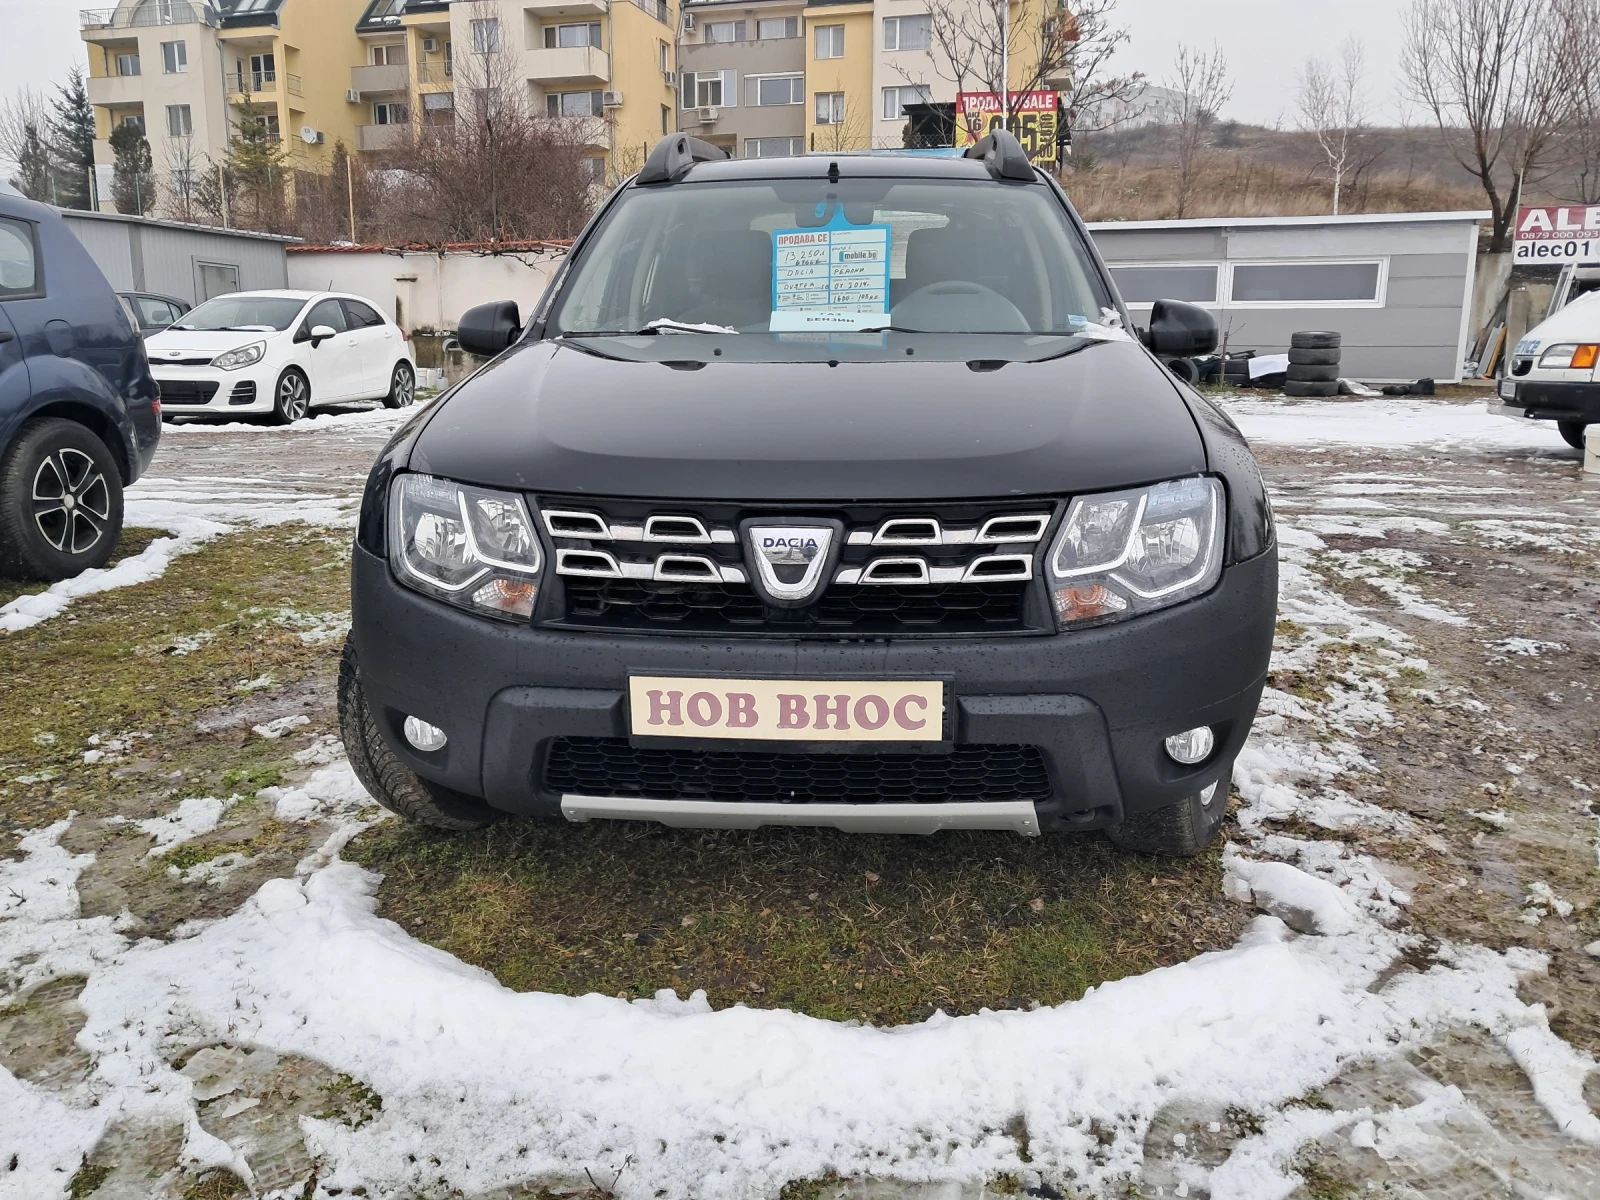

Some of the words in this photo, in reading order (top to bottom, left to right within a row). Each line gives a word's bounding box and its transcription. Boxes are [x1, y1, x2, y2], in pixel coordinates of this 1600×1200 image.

[778, 234, 815, 245] ПРОДАВА
[817, 233, 828, 243] СЕ
[1521, 231, 1550, 239] 0879
[1552, 231, 1574, 239] 000
[1576, 230, 1599, 238] 093
[1517, 240, 1590, 257] alec01
[844, 251, 877, 261] mobile.bg
[763, 537, 818, 548] DACIA
[646, 689, 759, 728] НОВ
[776, 693, 928, 731] ВНОС
